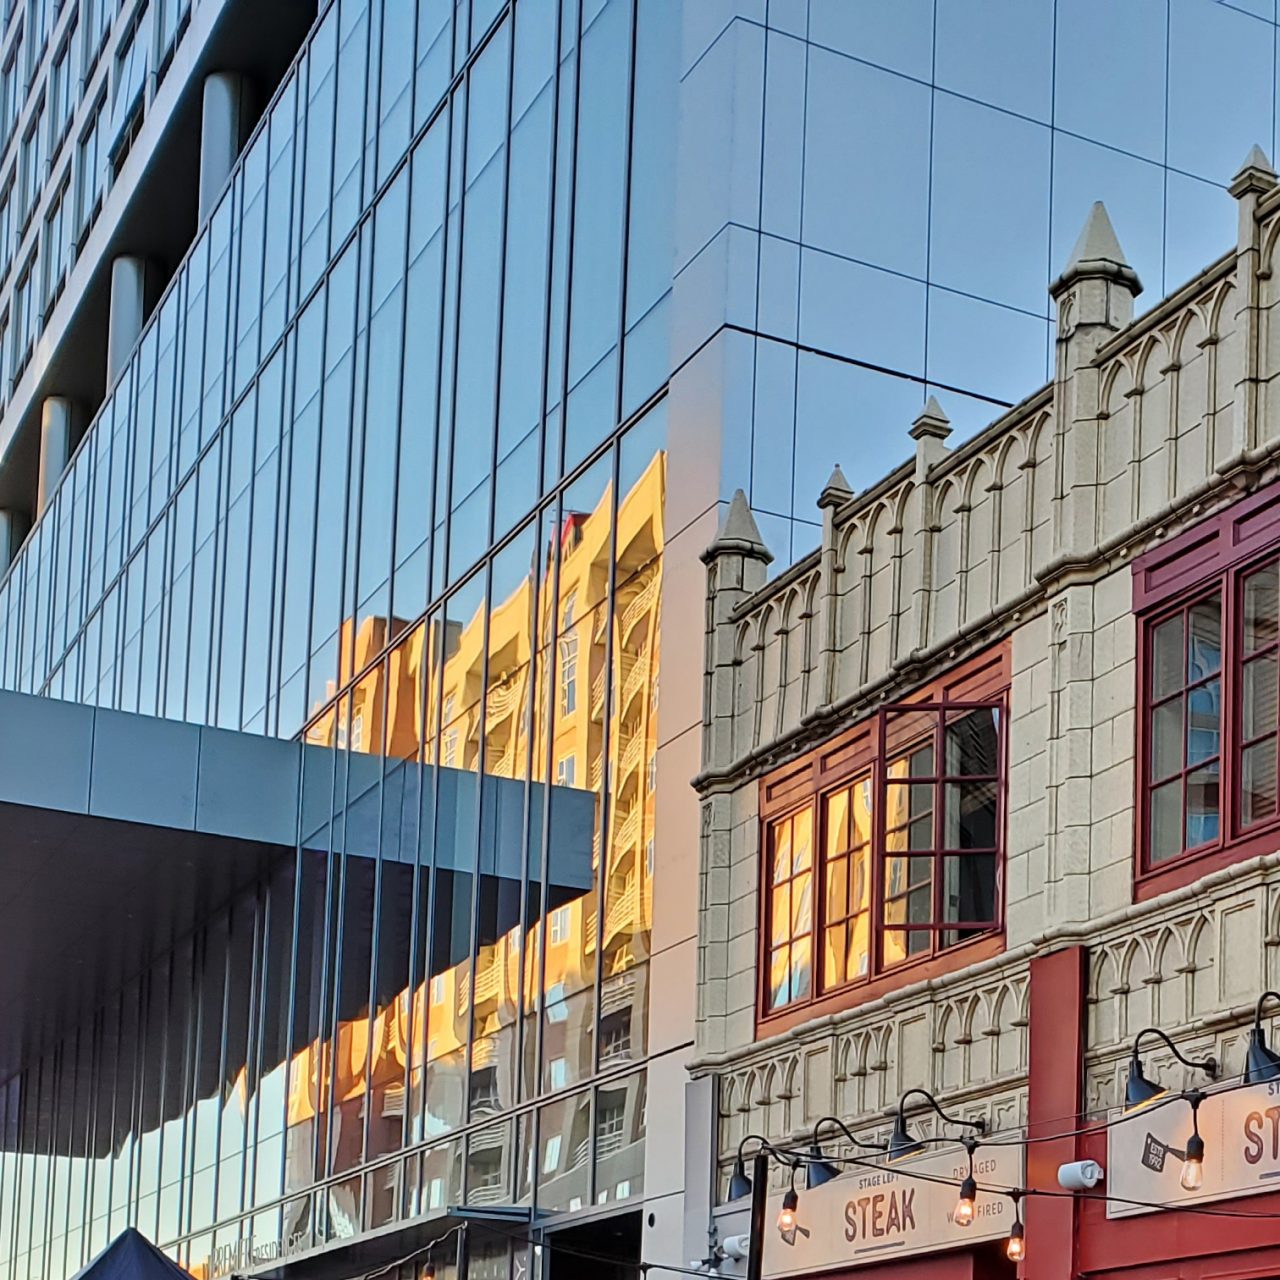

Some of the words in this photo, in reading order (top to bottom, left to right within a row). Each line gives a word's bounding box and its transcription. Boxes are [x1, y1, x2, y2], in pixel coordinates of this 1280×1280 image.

[859, 1175, 881, 1190] STAGE
[844, 1187, 916, 1242] STEAK
[977, 1201, 1004, 1218] FIRED
